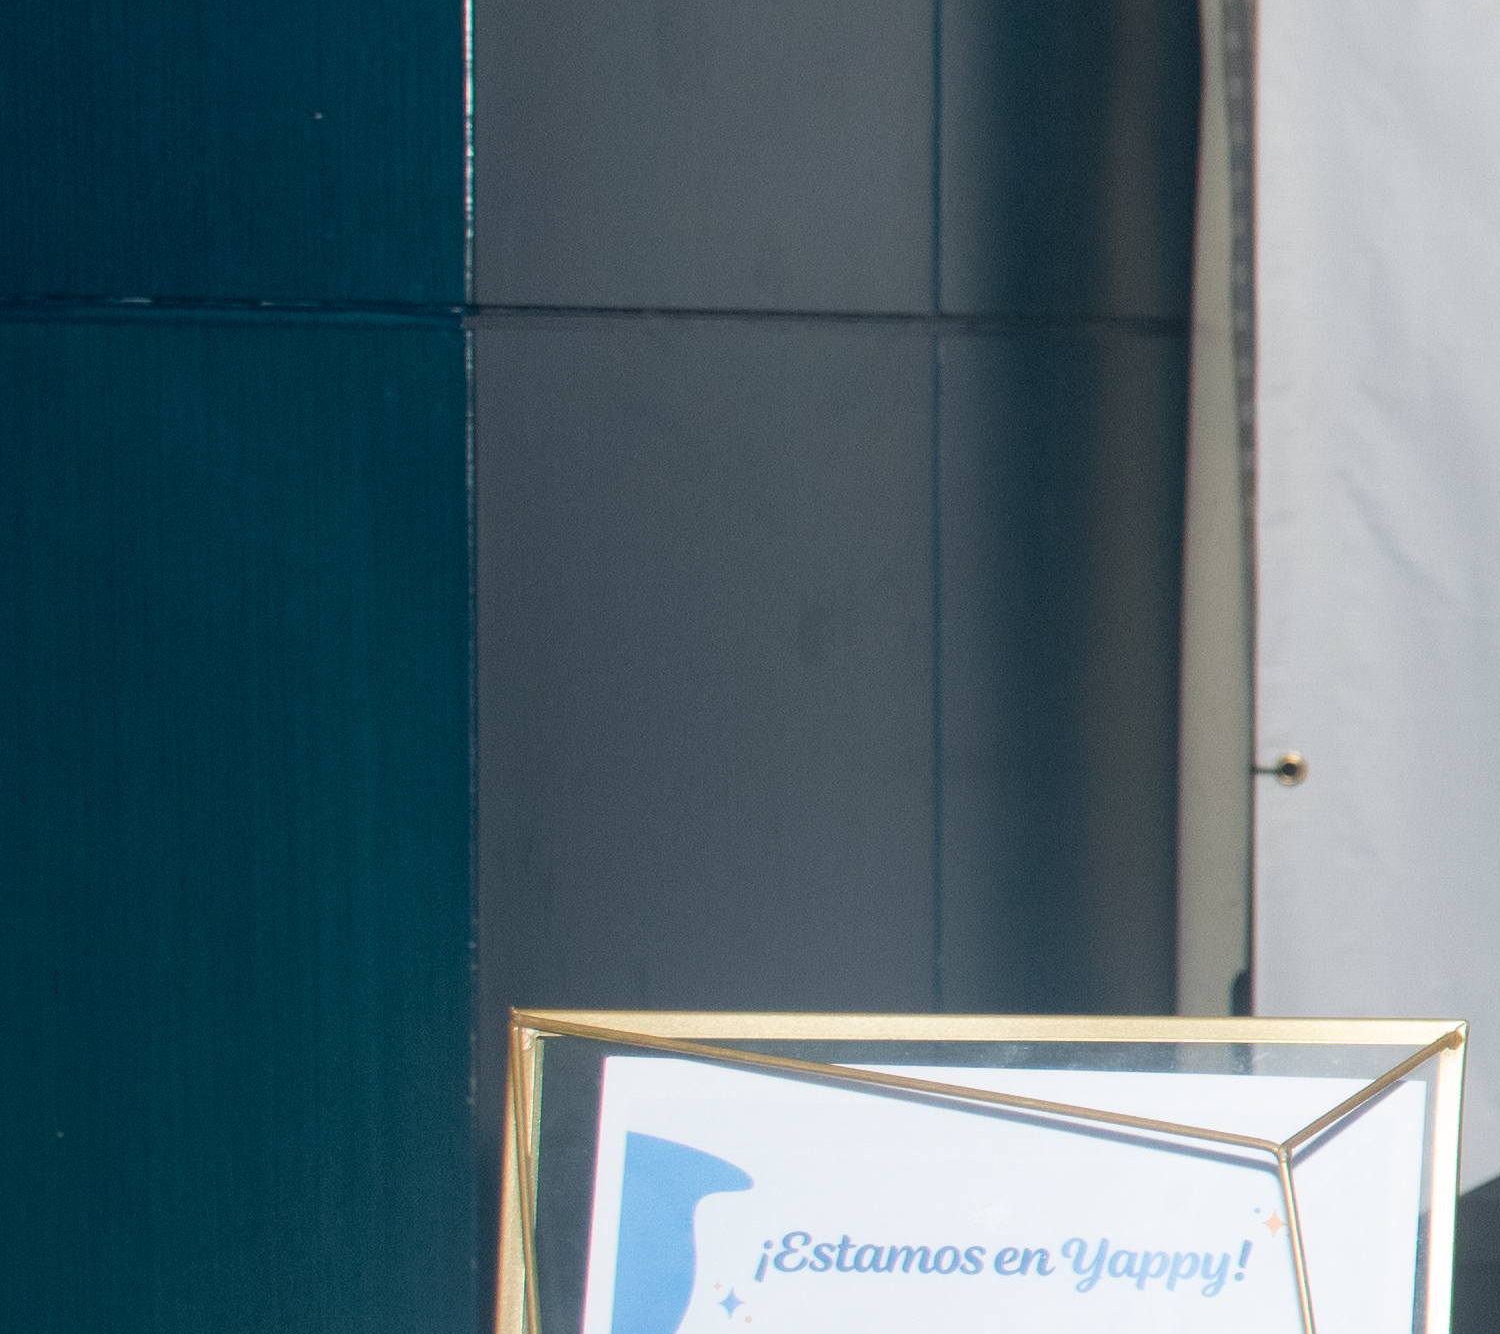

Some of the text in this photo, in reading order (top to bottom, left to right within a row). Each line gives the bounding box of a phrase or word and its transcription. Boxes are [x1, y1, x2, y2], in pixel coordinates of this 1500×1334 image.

[752, 1230, 1254, 1298] ¡Estamos en Yappy!
